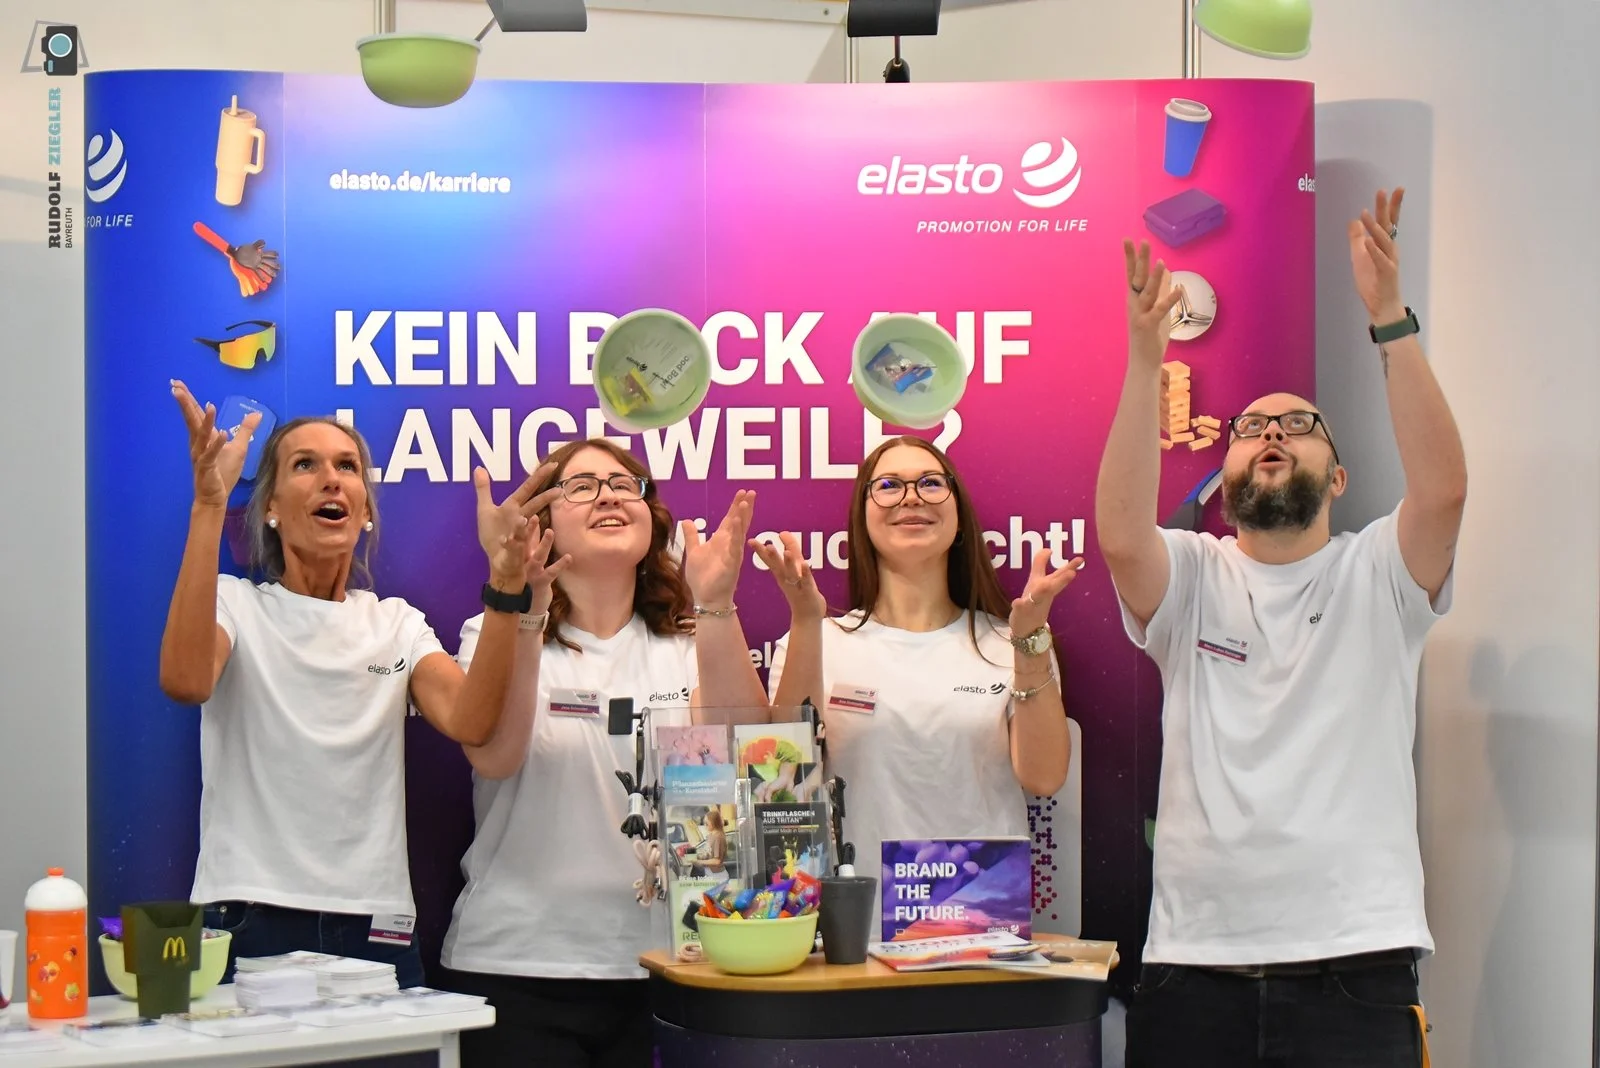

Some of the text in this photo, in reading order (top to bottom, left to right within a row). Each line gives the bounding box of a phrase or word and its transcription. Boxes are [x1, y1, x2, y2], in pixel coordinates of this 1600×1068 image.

[329, 168, 511, 193] elasto.de/karriere
[857, 155, 1003, 195] elasto
[87, 214, 134, 227] FOR LIFE
[917, 219, 1088, 233] PROMOTION FOR LIFE
[335, 310, 1033, 386] KEIN BCK UF
[752, 530, 849, 571] auc
[982, 516, 1085, 570] cht!
[649, 691, 679, 702] elasto
[953, 684, 987, 695] elasto
[894, 862, 957, 878] BRAND
[894, 883, 931, 900] THE
[894, 905, 970, 922] FUTURE.
[682, 931, 702, 941] RE
